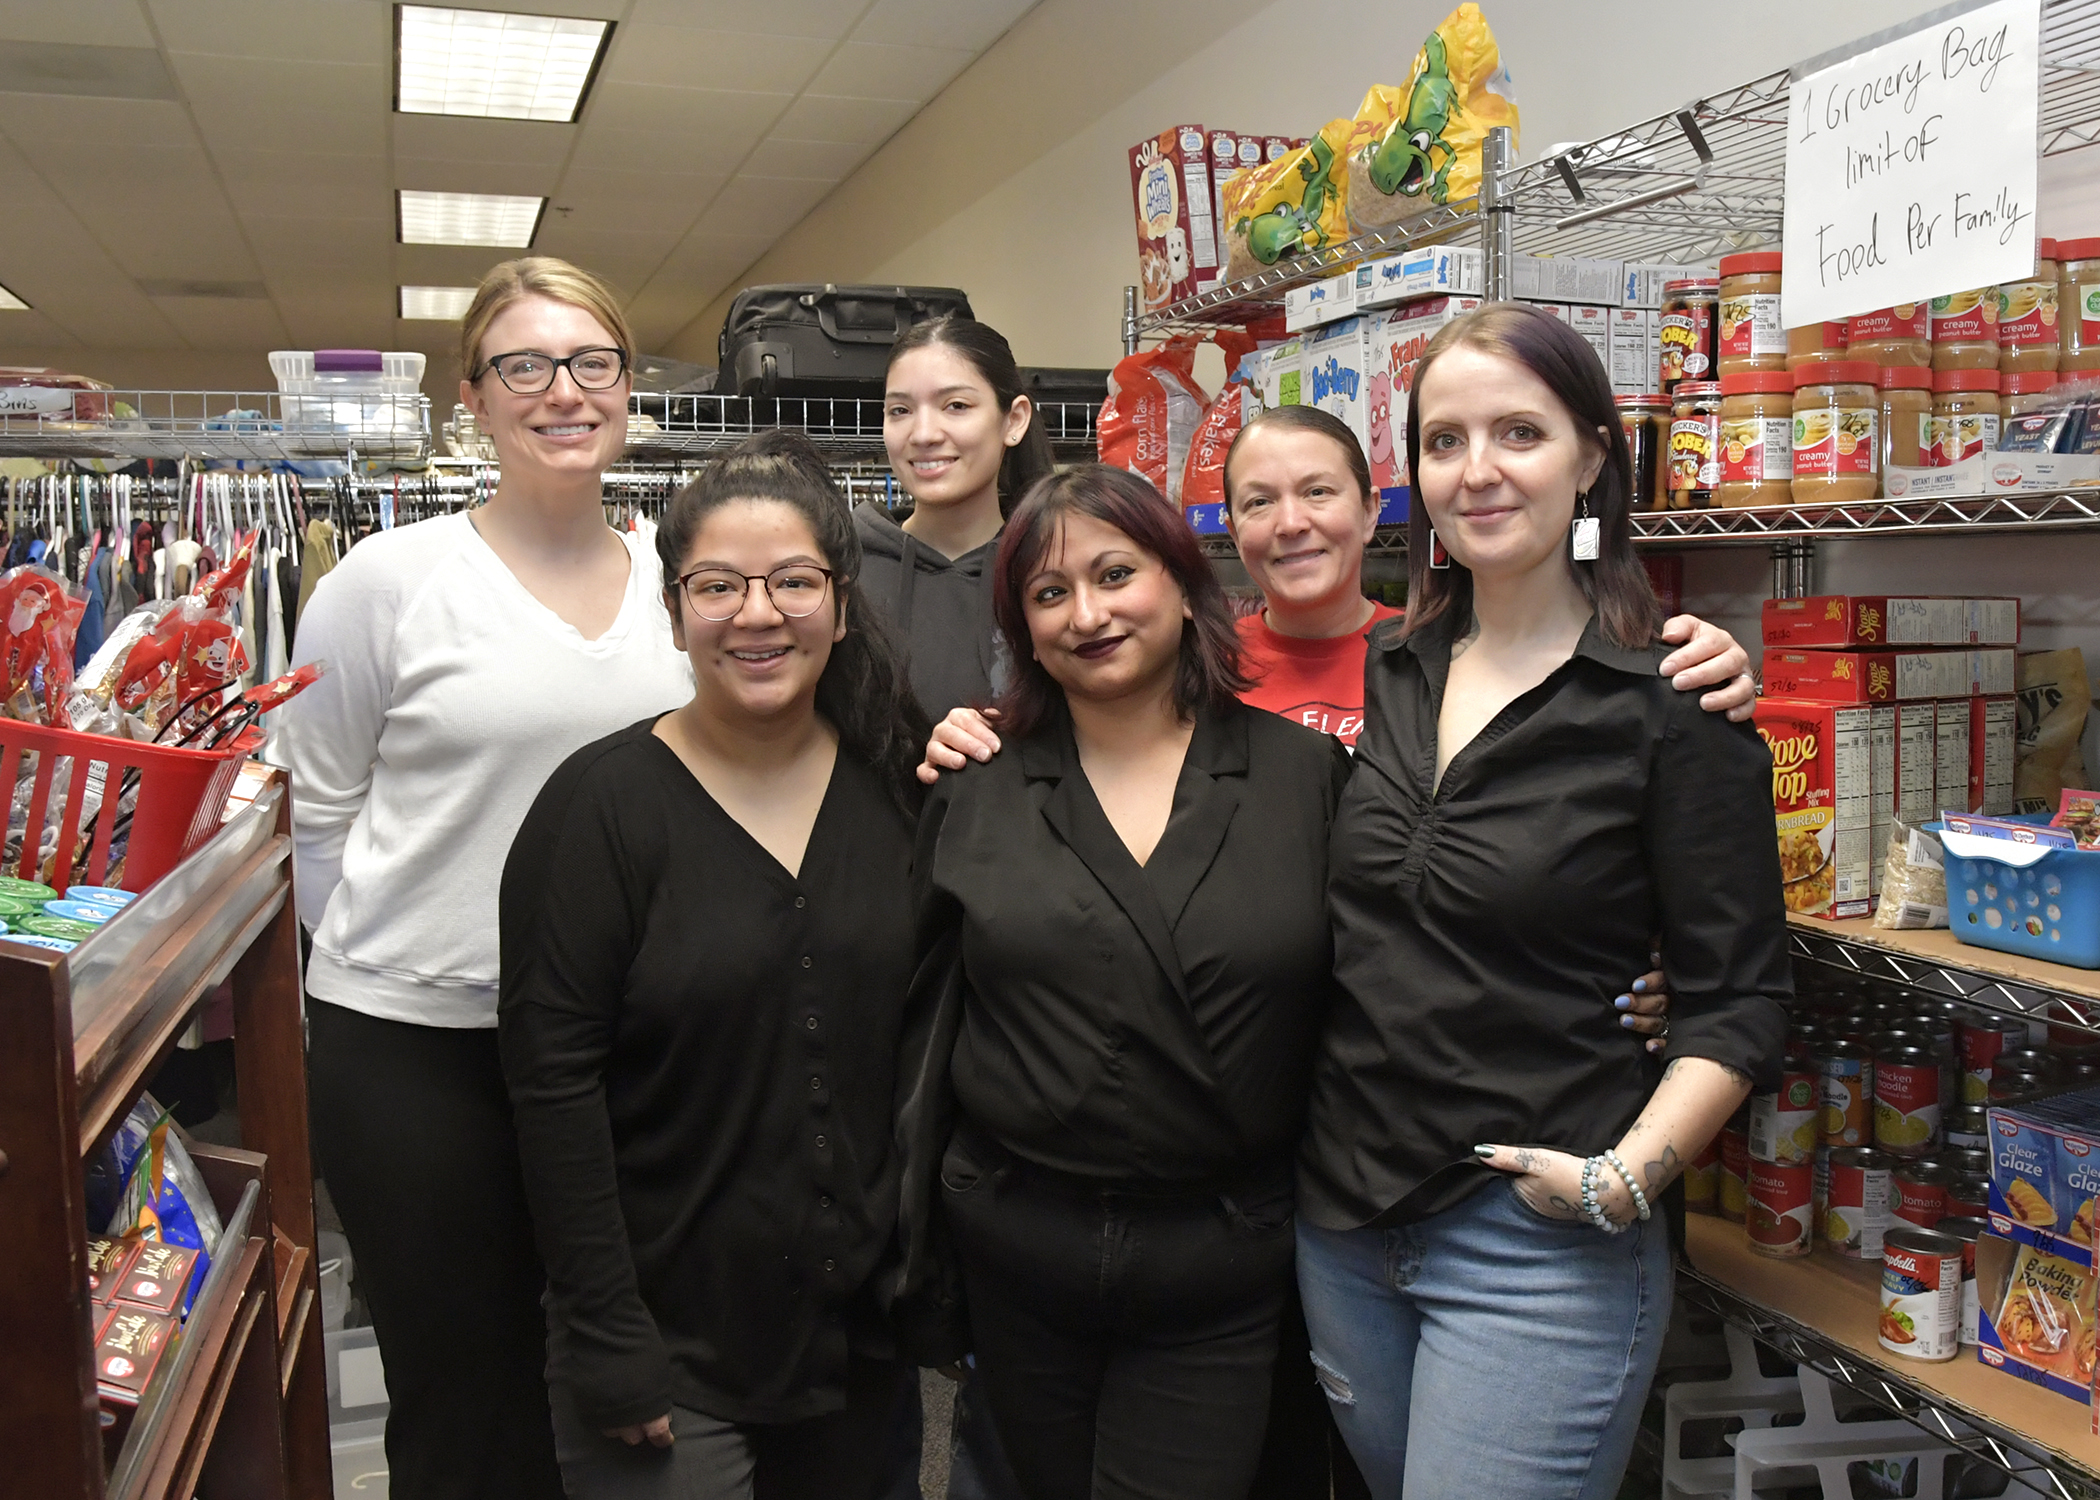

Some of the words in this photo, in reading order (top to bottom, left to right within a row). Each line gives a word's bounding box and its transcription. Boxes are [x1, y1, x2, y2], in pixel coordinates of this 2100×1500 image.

[1800, 89, 1816, 143] 1
[1826, 60, 1930, 129] Grocery
[1942, 24, 2014, 92] Bag
[1847, 131, 1900, 189] limit
[1147, 174, 1169, 205] Mini
[1815, 212, 1887, 287] Food
[1907, 203, 1942, 254] Per
[1955, 187, 2032, 245] Family
[1857, 316, 1890, 328] creamy
[1942, 319, 1979, 331] creamy
[2002, 323, 2038, 335] creamy
[1137, 427, 1148, 461] corn
[1200, 413, 1227, 466] flakes
[2015, 433, 2040, 442] YEAST
[1799, 451, 1830, 462] creamy
[1857, 603, 1877, 642] Stove
[1869, 608, 1881, 628] Top
[1868, 660, 1888, 699] Stove
[1879, 665, 1892, 684] Top
[69, 702, 82, 716] 105
[1836, 710, 1856, 718] Nutrition
[1805, 788, 1830, 801] Stuffing
[1808, 799, 1820, 808] Mix
[1877, 1070, 1912, 1084] chicken
[1877, 1079, 1908, 1093] noodle
[2006, 1142, 2038, 1160] Clear
[1998, 1152, 2043, 1177] Glaze
[1752, 1173, 1785, 1188] tomato
[1903, 1194, 1942, 1208] tomato
[2025, 1257, 2083, 1288] Baking
[2018, 1271, 2079, 1302] Powder
